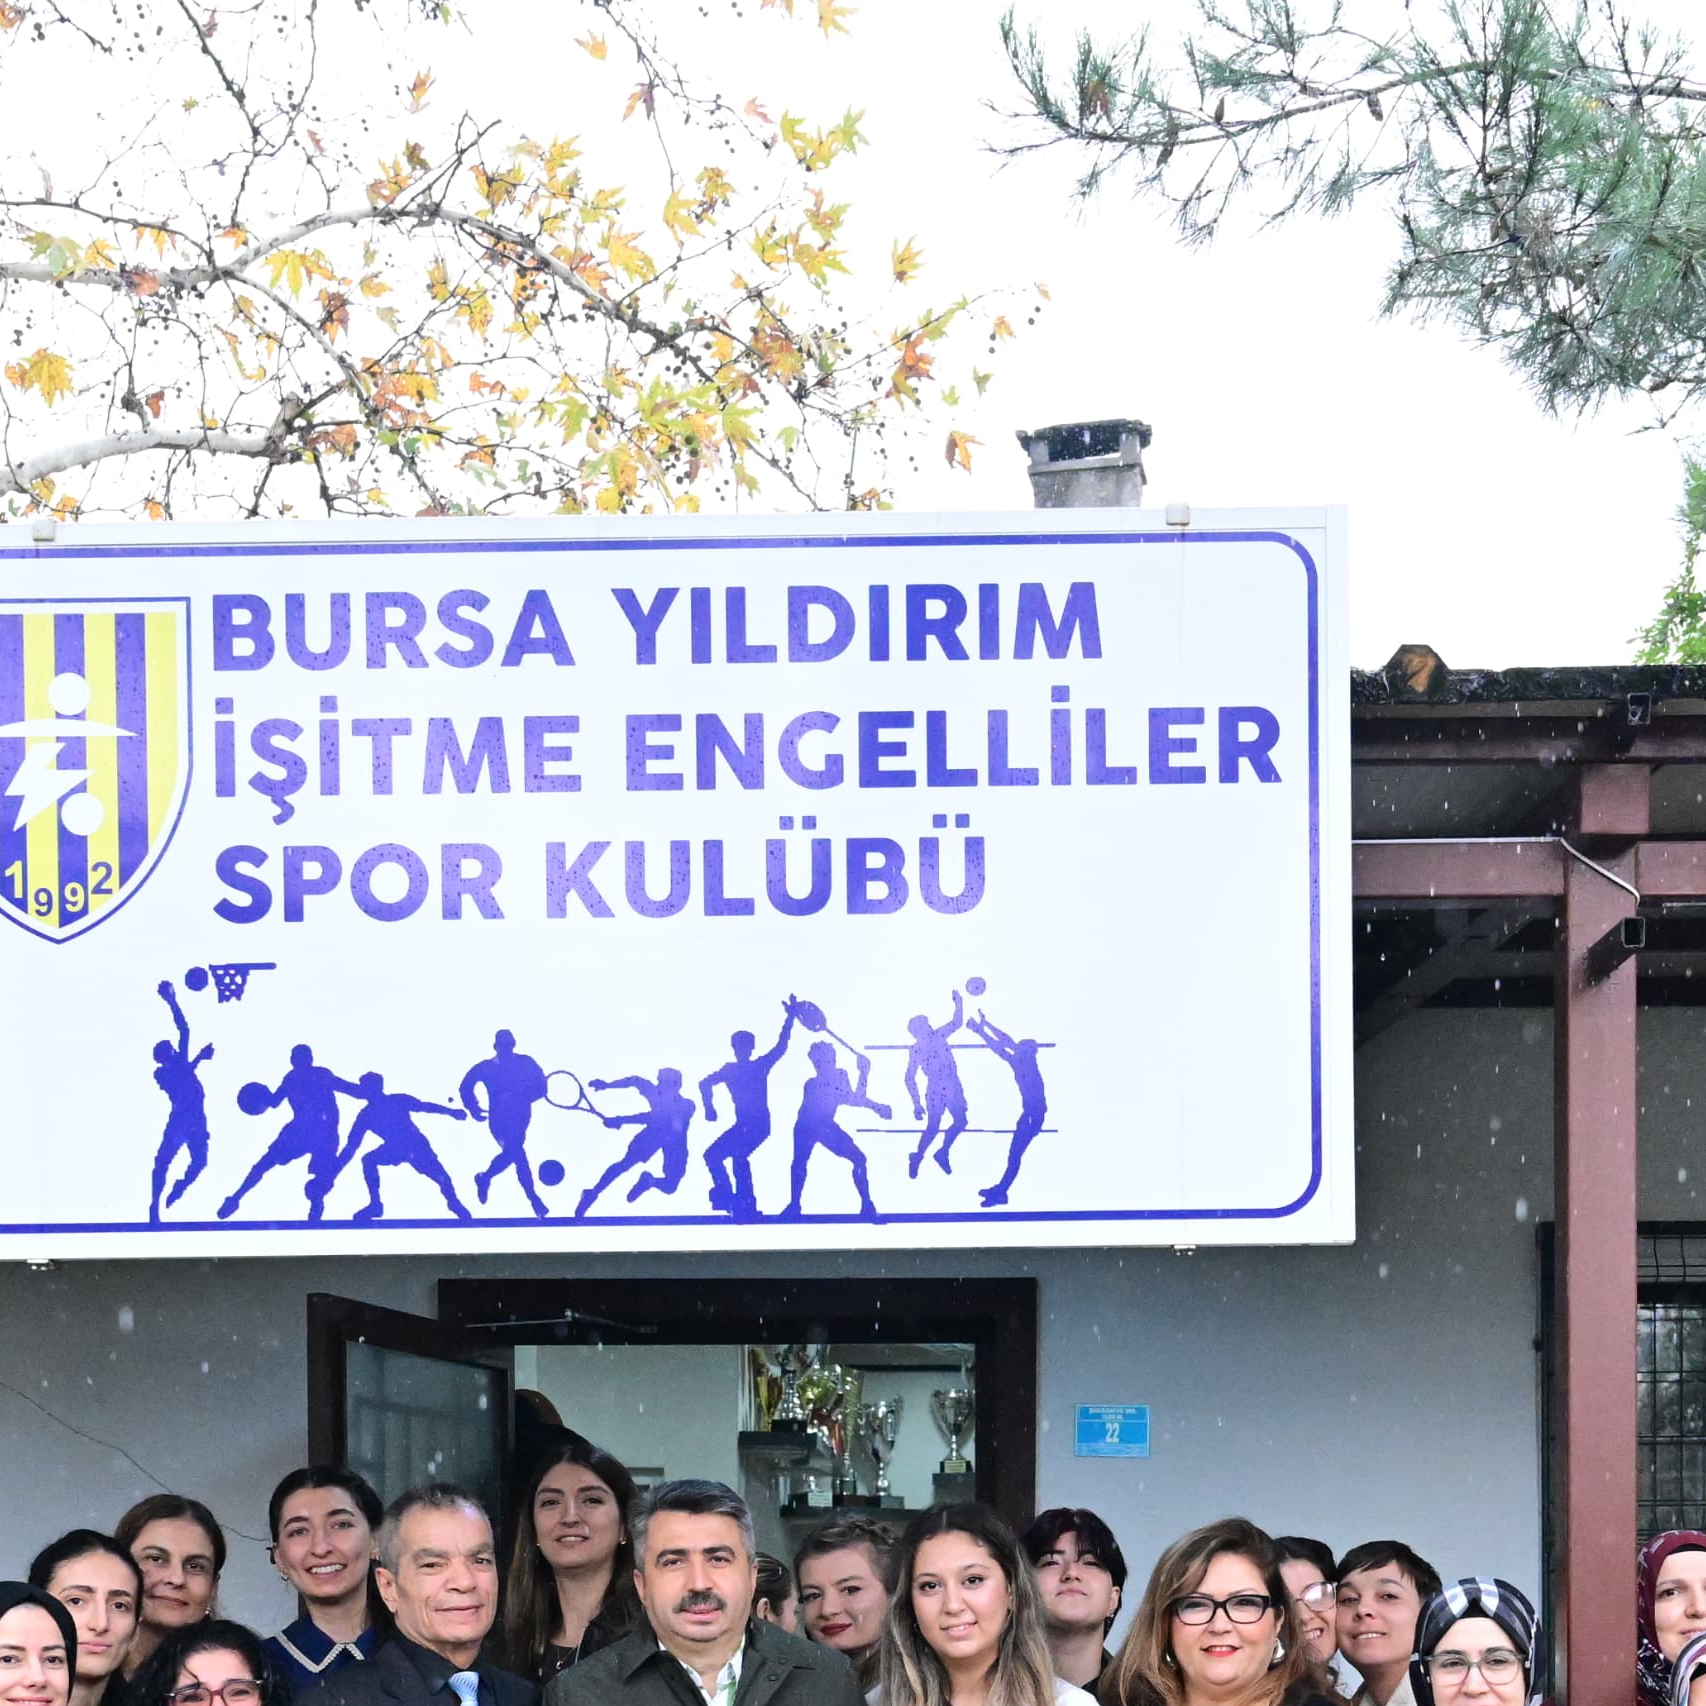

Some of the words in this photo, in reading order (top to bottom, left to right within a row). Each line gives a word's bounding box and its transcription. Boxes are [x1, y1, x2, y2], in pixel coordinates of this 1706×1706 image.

[211, 588, 577, 673] BURSA
[610, 580, 1104, 667] YILDIRIM
[214, 694, 582, 828] İŞİTME
[624, 684, 1283, 792] ENGELLİLER
[4, 860, 113, 917] 1992
[212, 842, 505, 925] SPOR
[545, 812, 986, 920] KULÜBÜ
[1105, 1422, 1120, 1443] 22
